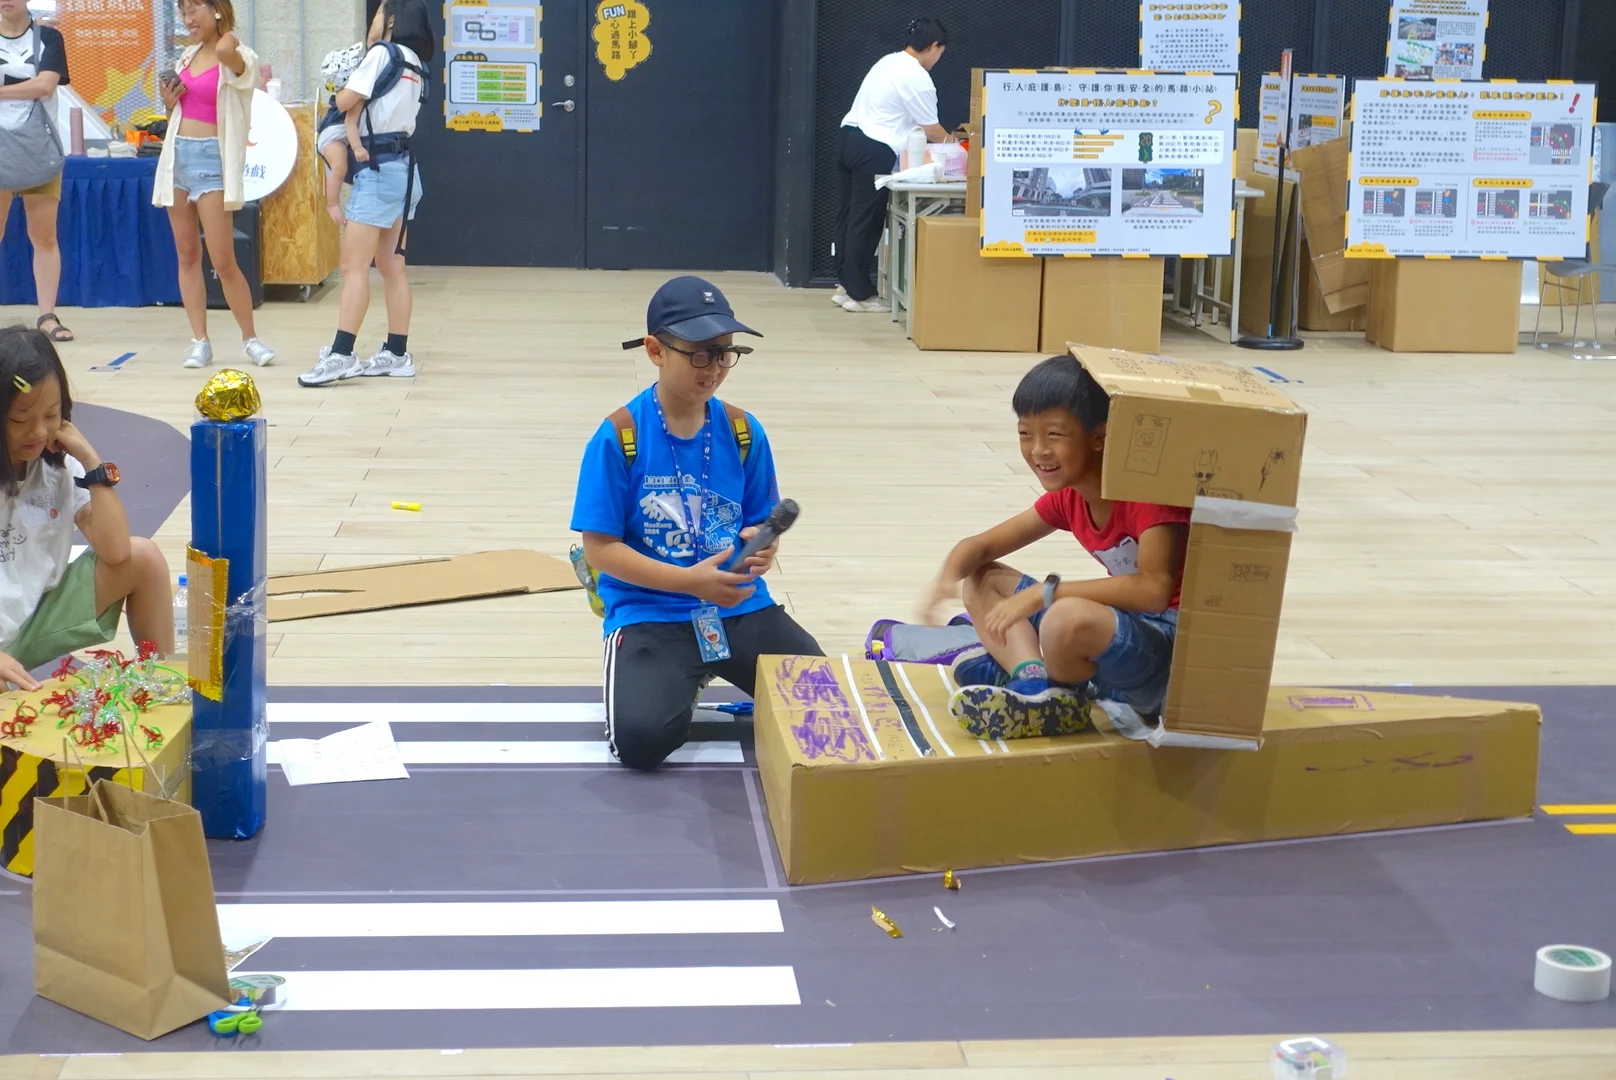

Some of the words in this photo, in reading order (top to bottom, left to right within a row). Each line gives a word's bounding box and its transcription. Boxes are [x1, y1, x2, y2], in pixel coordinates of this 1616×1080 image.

[603, 5, 625, 19] FUN
[610, 20, 621, 60] 心過馬路
[627, 9, 638, 60] 跟上小腳丫
